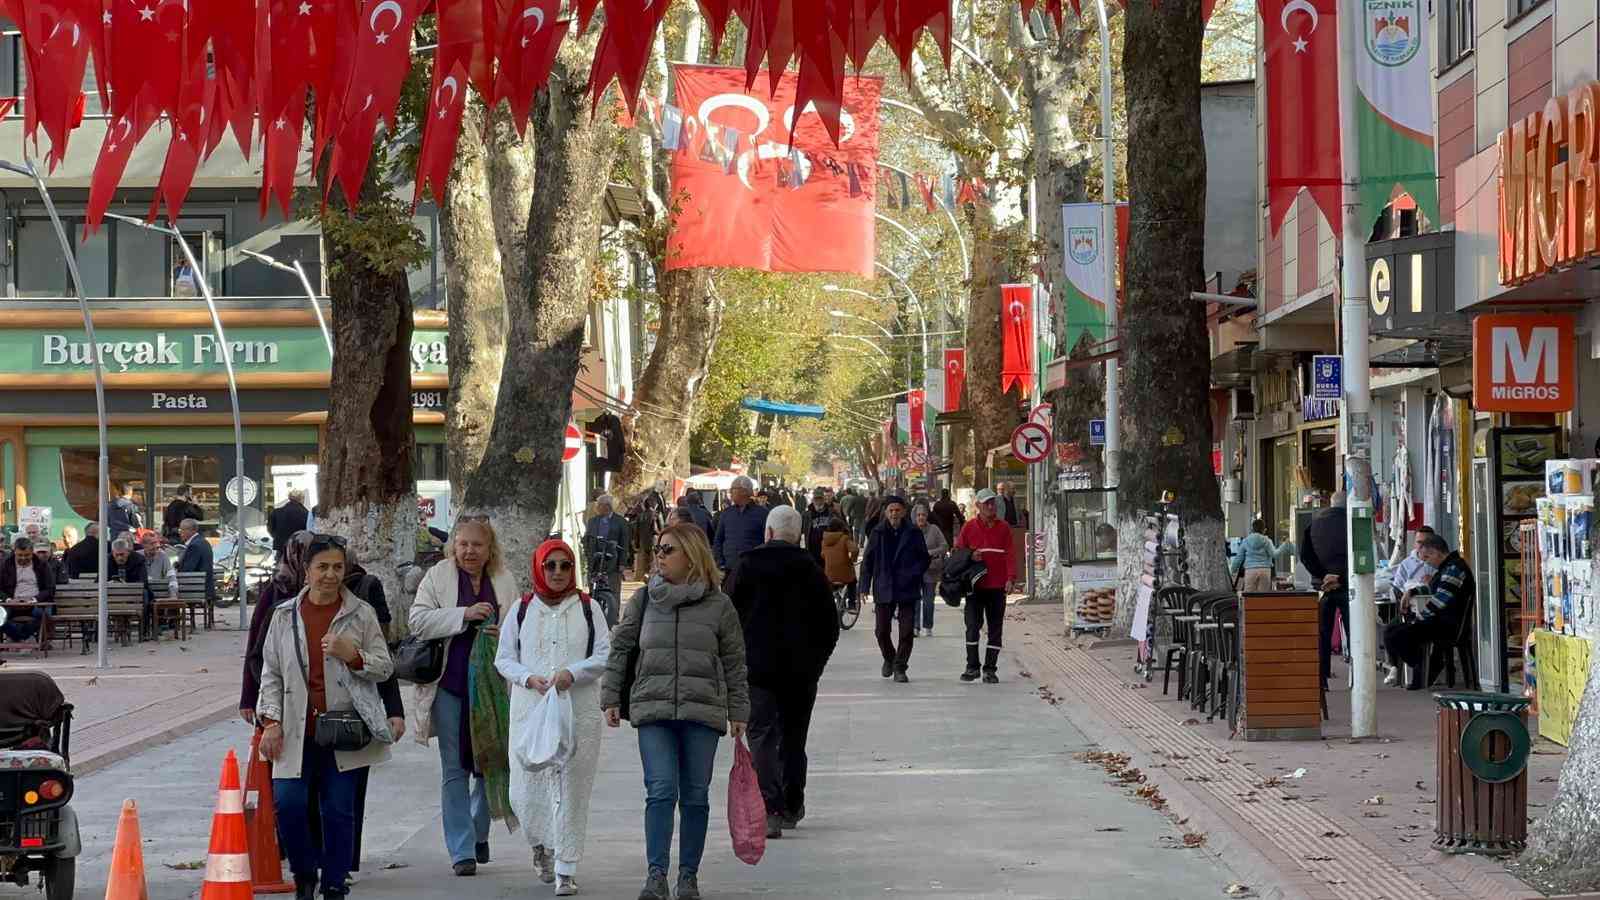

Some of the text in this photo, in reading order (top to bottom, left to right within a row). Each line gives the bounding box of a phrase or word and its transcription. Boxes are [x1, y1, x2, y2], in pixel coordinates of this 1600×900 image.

[43, 332, 279, 372] Burçak Fırın
[1491, 326, 1559, 384] M
[151, 392, 209, 409] Pasta
[411, 392, 443, 407] 1981
